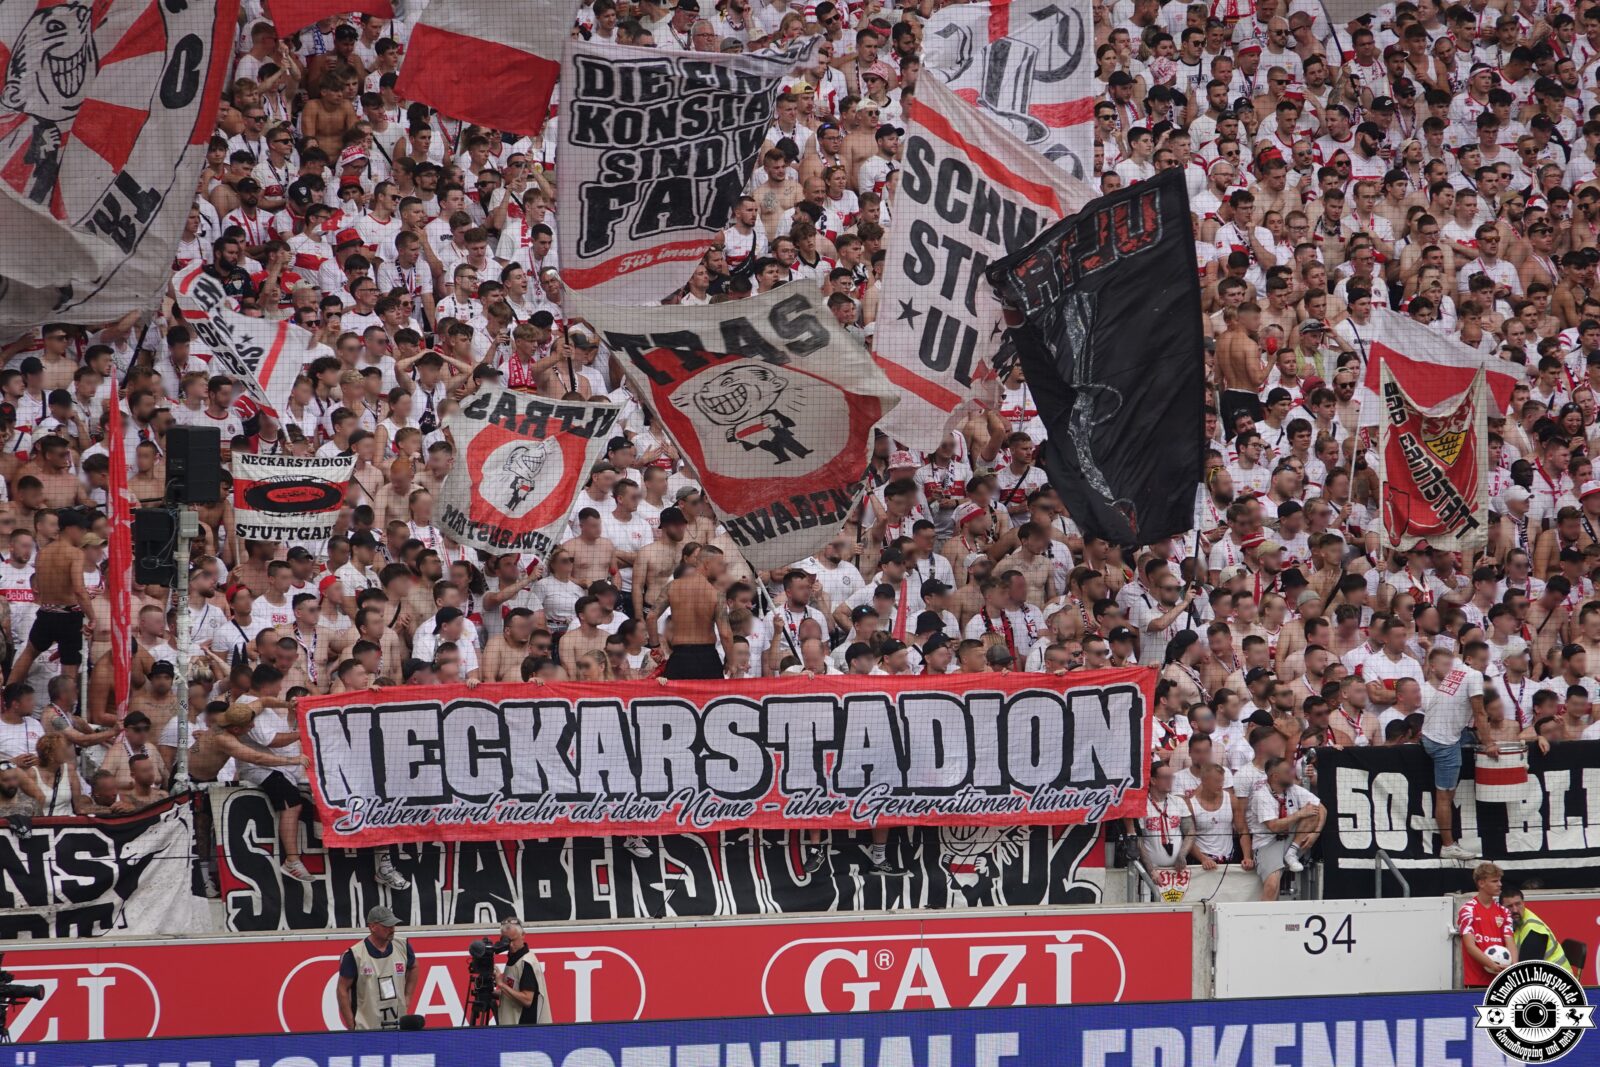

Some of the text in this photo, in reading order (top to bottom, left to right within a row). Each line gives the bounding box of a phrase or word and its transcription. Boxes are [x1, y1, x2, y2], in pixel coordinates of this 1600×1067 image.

[576, 57, 671, 103] DIE
[601, 141, 723, 184] SIND
[619, 251, 654, 275] Für
[241, 454, 353, 468] NECKARSTADION
[1384, 381, 1480, 540] BAD CANNSTATT
[236, 523, 335, 541] STUTTGAR
[310, 685, 1138, 804] NECKARSTADION
[336, 796, 433, 834] Bleiben
[435, 793, 501, 823] wird
[500, 794, 569, 823] mehr
[571, 794, 610, 823] als
[612, 794, 663, 821] dein
[665, 787, 754, 828] Name
[785, 788, 847, 818] über
[852, 783, 1025, 826] Generationen
[1029, 777, 1132, 823] hinweg!
[1304, 914, 1357, 955] 34
